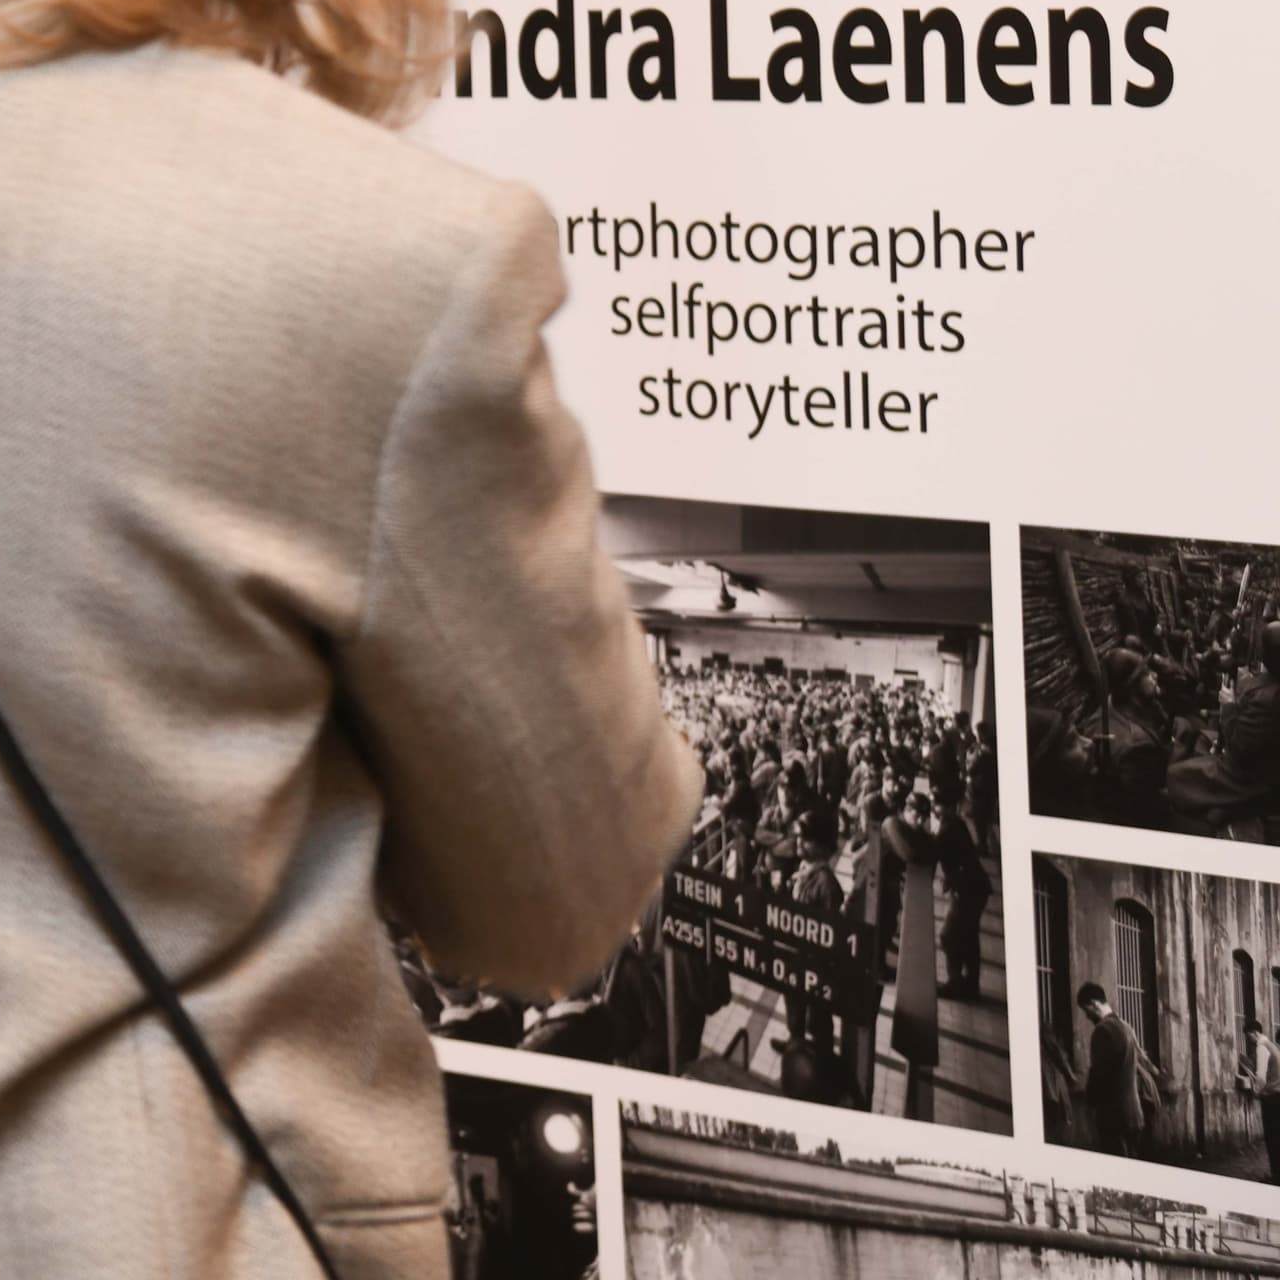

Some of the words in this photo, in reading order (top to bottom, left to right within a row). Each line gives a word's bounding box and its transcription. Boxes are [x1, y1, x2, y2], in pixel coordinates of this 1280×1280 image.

[555, 201, 1036, 283] rtphotographer
[610, 281, 966, 356] selfportraits
[639, 368, 939, 440] storyteller
[662, 915, 705, 949] A255
[674, 871, 723, 909] TREIN
[734, 894, 744, 917] 1
[766, 904, 835, 949] NOORD
[846, 933, 858, 958] 1
